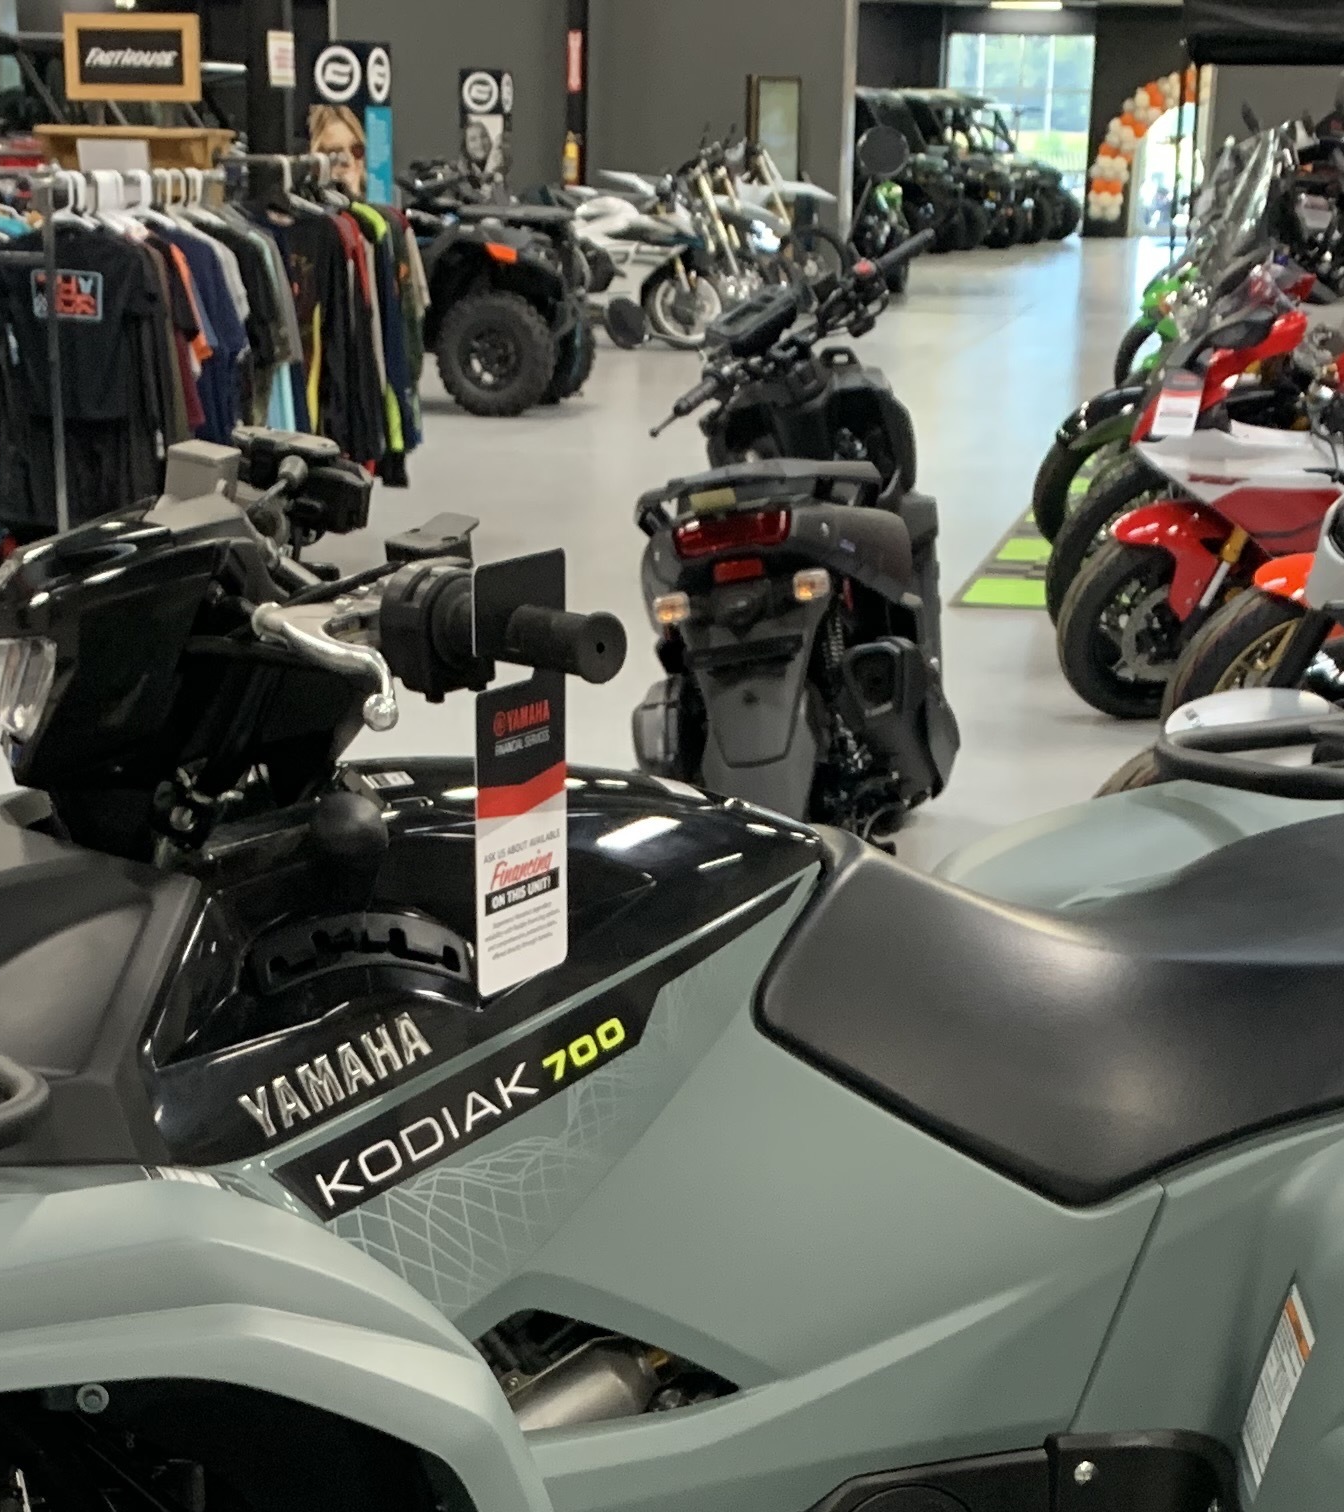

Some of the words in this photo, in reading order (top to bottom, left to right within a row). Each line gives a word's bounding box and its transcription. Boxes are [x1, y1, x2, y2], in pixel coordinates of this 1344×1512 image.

[506, 699, 551, 732] YAMAHA
[483, 852, 496, 864] ASK
[507, 840, 527, 855] ABOUT
[529, 828, 560, 847] AVAILABLE
[489, 849, 553, 891] Financing
[491, 893, 506, 910] ON
[506, 885, 526, 904] THIS
[238, 1011, 434, 1139] YAMAHA
[315, 1061, 540, 1208] KODIAK
[542, 1017, 627, 1083] 700
